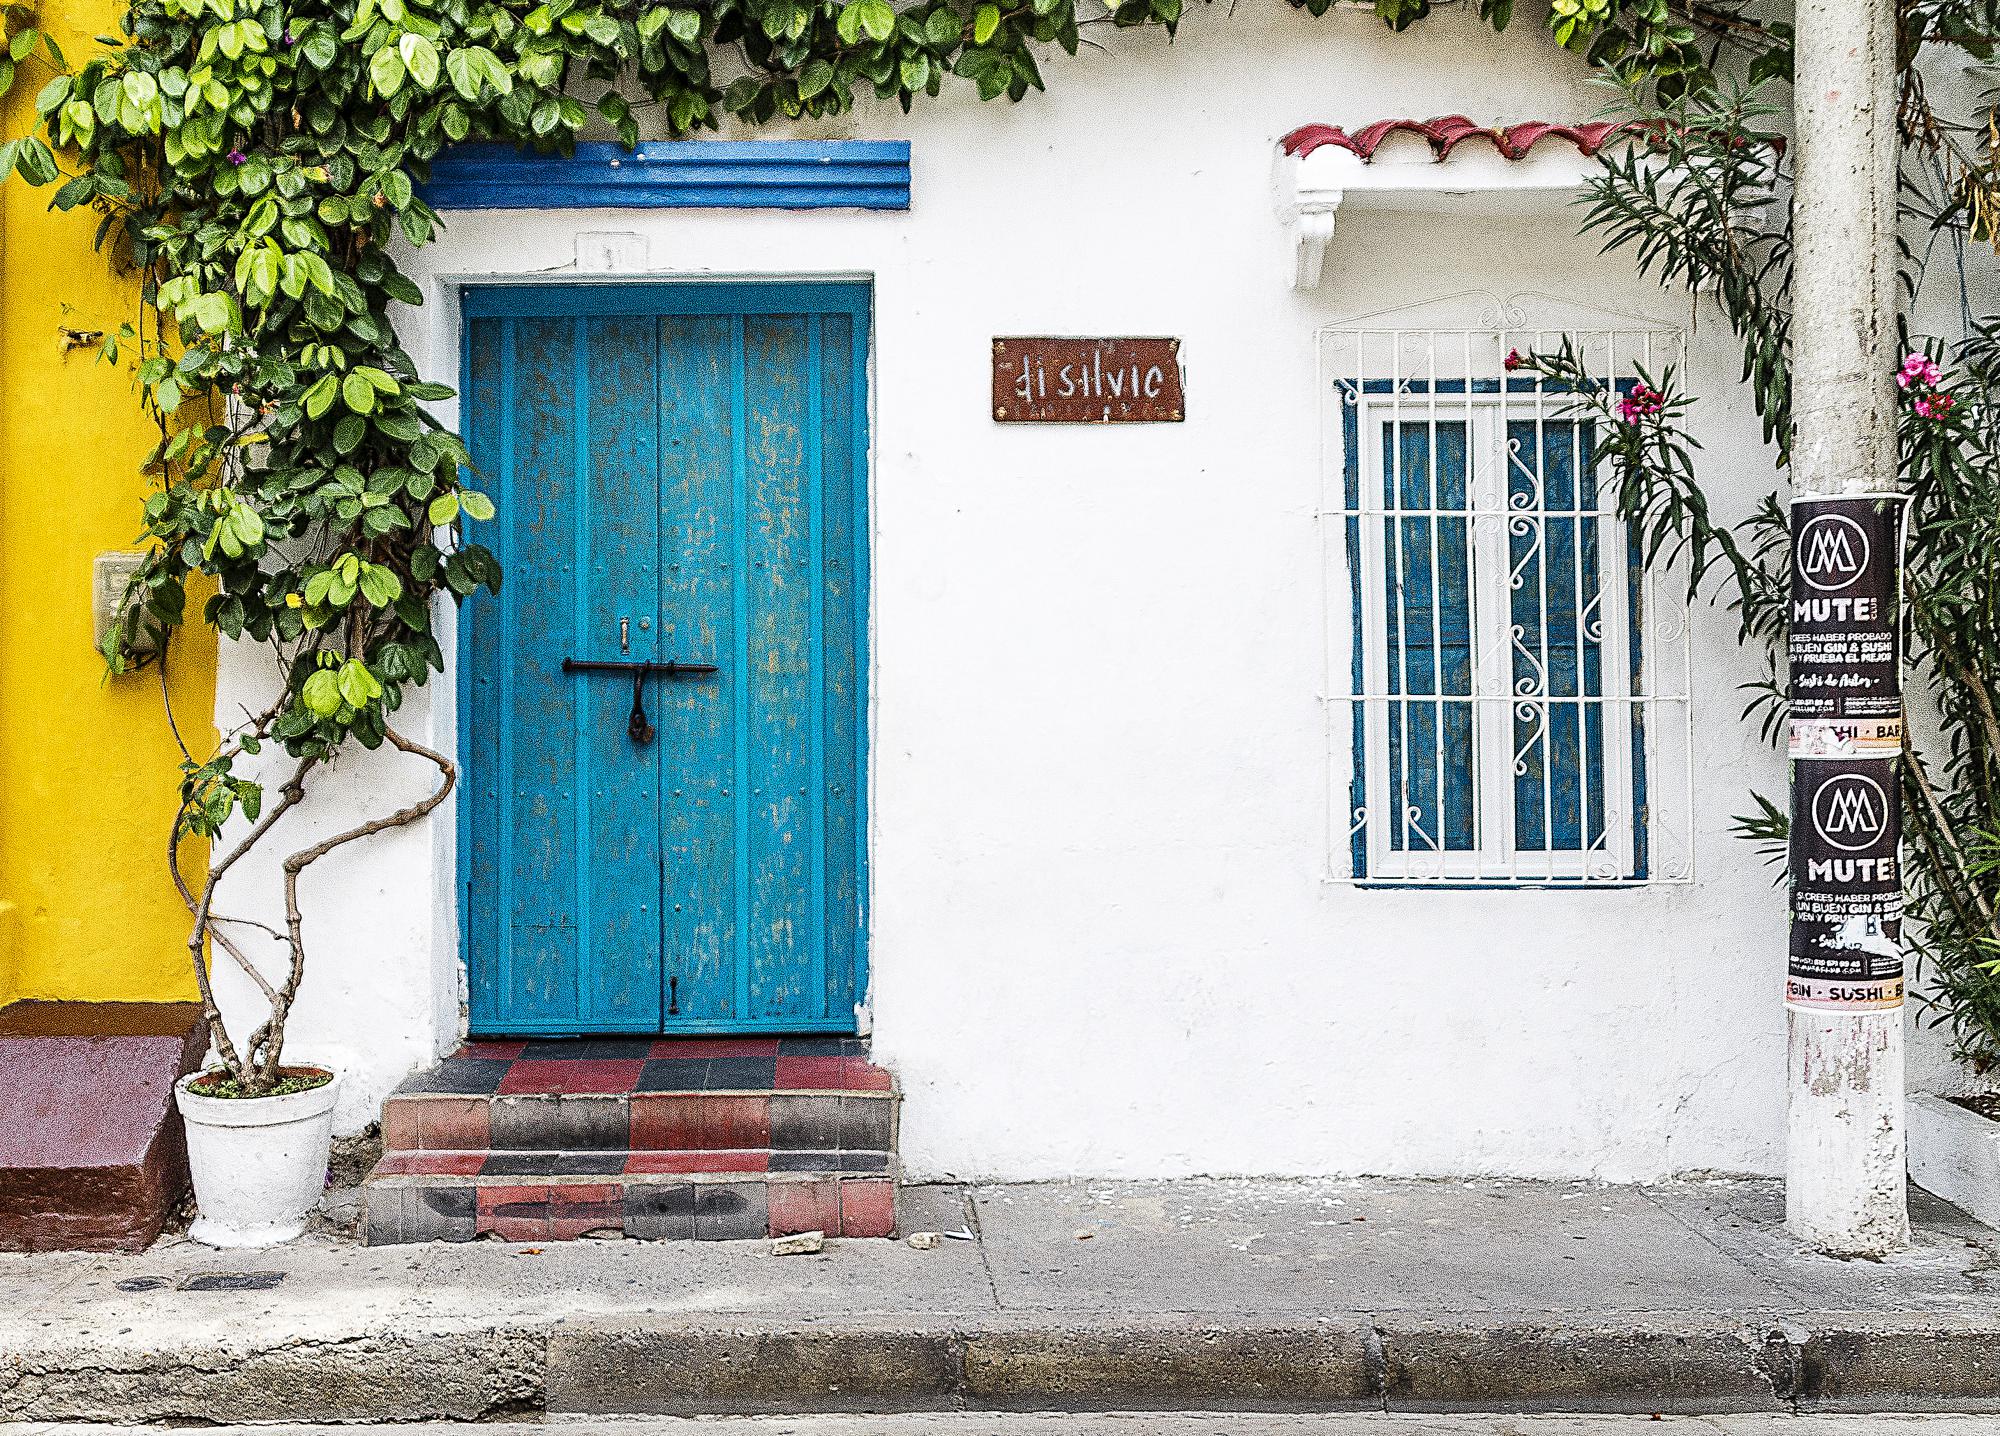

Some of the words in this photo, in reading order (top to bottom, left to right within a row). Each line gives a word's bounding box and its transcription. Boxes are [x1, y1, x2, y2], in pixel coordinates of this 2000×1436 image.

[1015, 353, 1046, 402] di
[1793, 597, 1871, 623] MUTE
[1812, 633, 1846, 642] HABER
[1823, 642, 1848, 654] GIN
[1849, 642, 1860, 653] &
[1861, 641, 1892, 653] SUSHI
[1803, 653, 1844, 664] PRUEBA
[1845, 653, 1860, 664] EL
[1861, 652, 1892, 664] MEJOR
[1808, 857, 1891, 882] MUTE
[1804, 892, 1834, 902] CREES
[1834, 894, 1871, 903] HABER
[1811, 902, 1847, 914] BUEN
[1848, 903, 1873, 914] GIN
[1873, 902, 1883, 913] &
[1815, 913, 1824, 922] Y
[1791, 982, 1811, 998] GIN
[1829, 986, 1883, 1001] SUSHI
